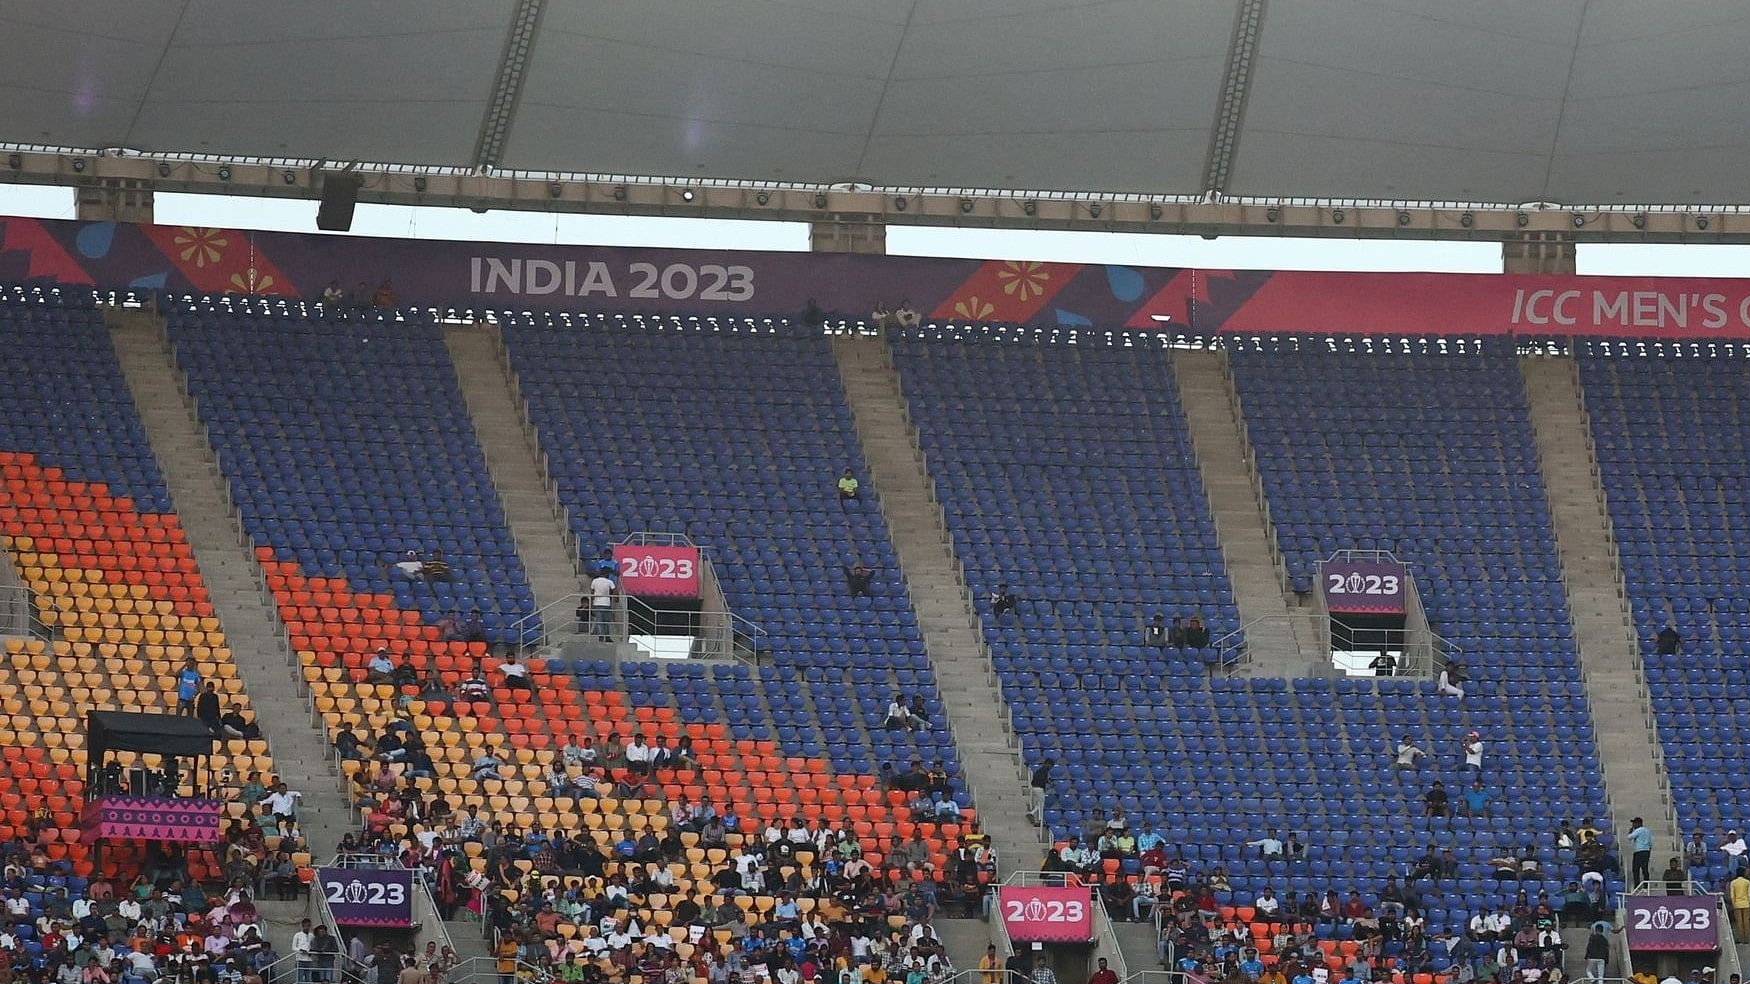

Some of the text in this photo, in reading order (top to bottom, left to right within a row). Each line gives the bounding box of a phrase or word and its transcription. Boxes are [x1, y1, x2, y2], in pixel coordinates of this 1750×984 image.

[470, 257, 756, 302] INDIA 2023
[1511, 289, 1582, 326] ICC
[1592, 290, 1727, 330] MEN'S
